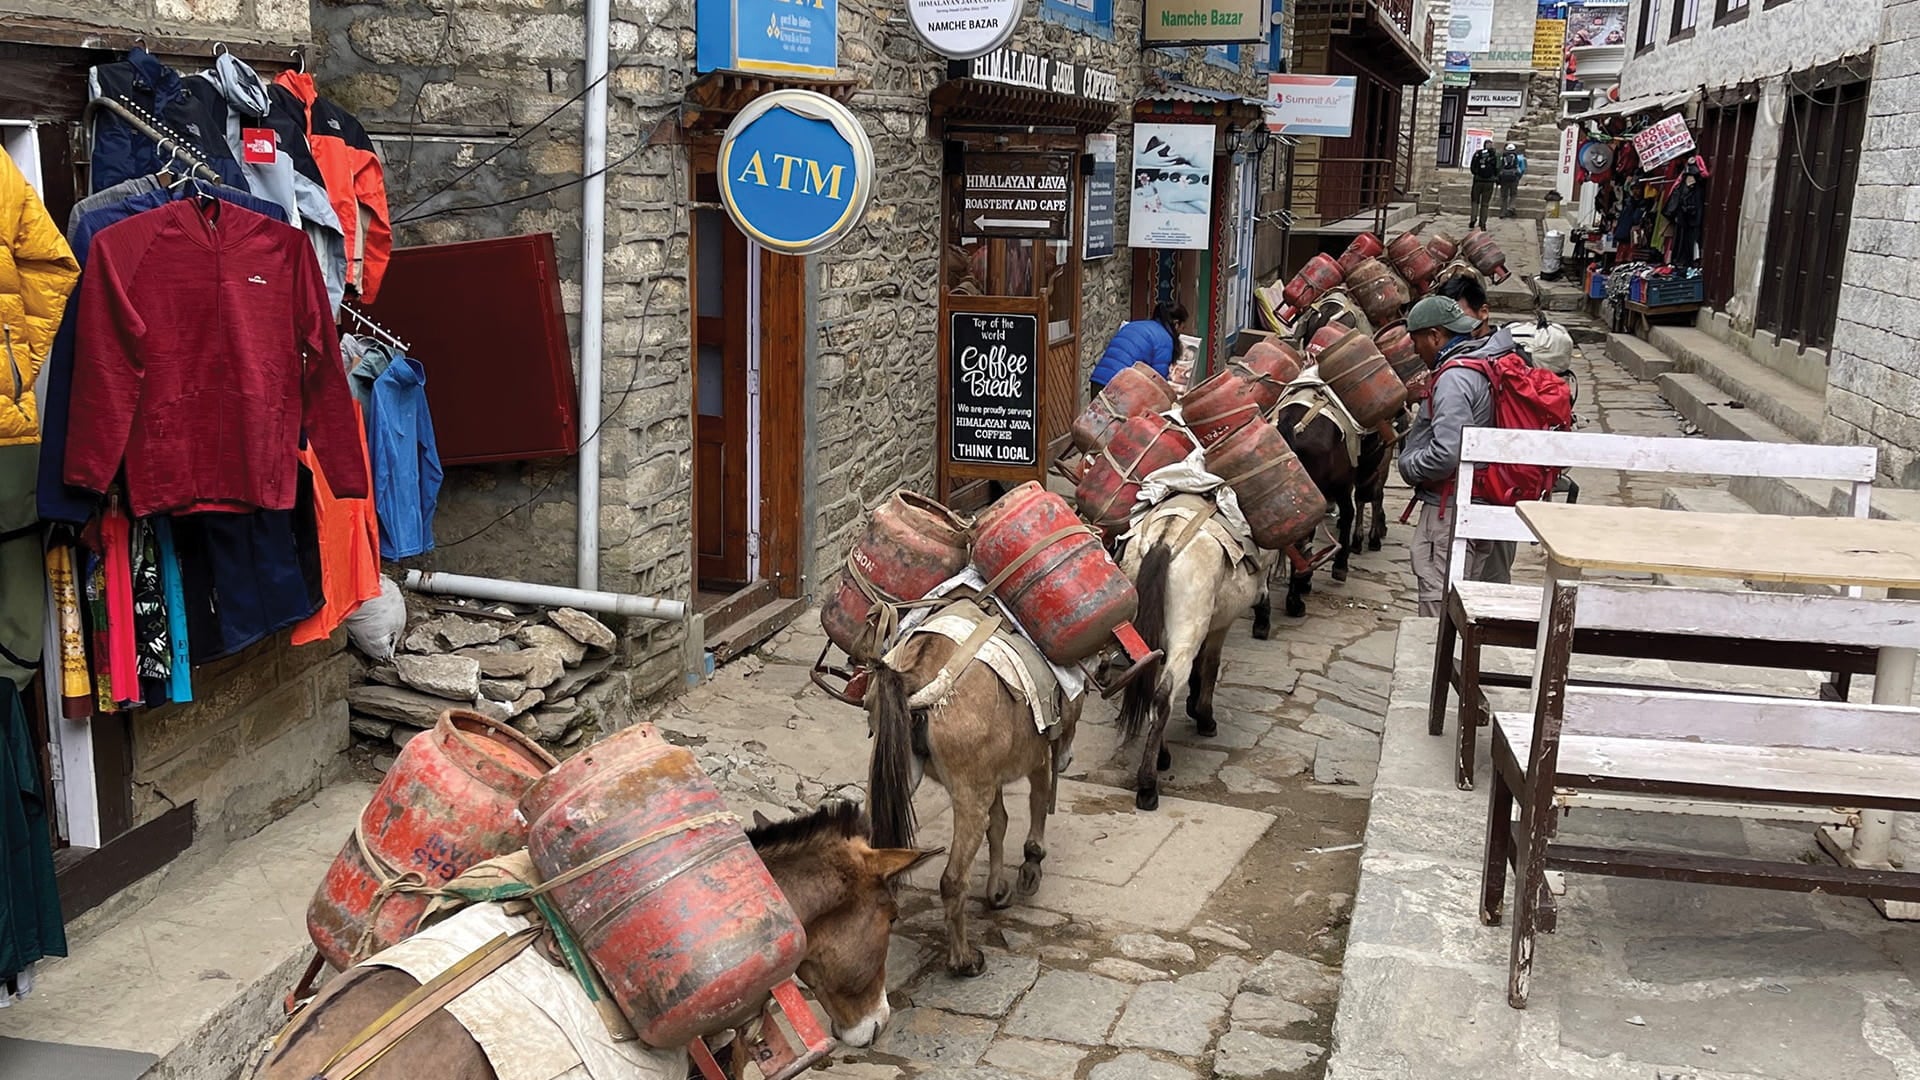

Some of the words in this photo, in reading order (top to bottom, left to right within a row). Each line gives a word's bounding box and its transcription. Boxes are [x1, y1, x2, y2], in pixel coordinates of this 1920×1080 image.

[928, 21, 967, 32] NAMCHE
[969, 18, 998, 29] BAZAR
[1161, 9, 1207, 27] Namche
[1211, 8, 1244, 26] Bazar
[973, 48, 1048, 90] HIMALAYAN
[1052, 60, 1075, 95] JAVA
[1083, 67, 1116, 102] COFFEE
[1285, 94, 1323, 105] Summit
[1641, 144, 1662, 161] GIFT
[1663, 132, 1689, 149] SHOP
[737, 150, 847, 201] ATM
[966, 174, 1036, 189] HIMALAYAN
[1037, 175, 1067, 190] JAVA
[965, 198, 1014, 210] ROASTERY
[1014, 199, 1038, 211] AND
[1039, 199, 1066, 212] CAFE
[972, 318, 986, 330] Top
[990, 318, 999, 328] of
[1001, 317, 1014, 329] the
[981, 330, 1005, 341] world
[961, 345, 1027, 379] Coffee
[961, 370, 1022, 398] Break
[957, 403, 969, 412] We
[970, 405, 982, 414] are
[983, 406, 1006, 416] proudly
[1007, 408, 1032, 418] serving
[956, 417, 1007, 428] HIMALAYAN
[1009, 419, 1031, 430] JAVA
[975, 430, 1012, 440] COFFEE
[957, 443, 993, 458] THINK
[997, 445, 1030, 461] LOCAL
[414, 847, 457, 881] GAS
